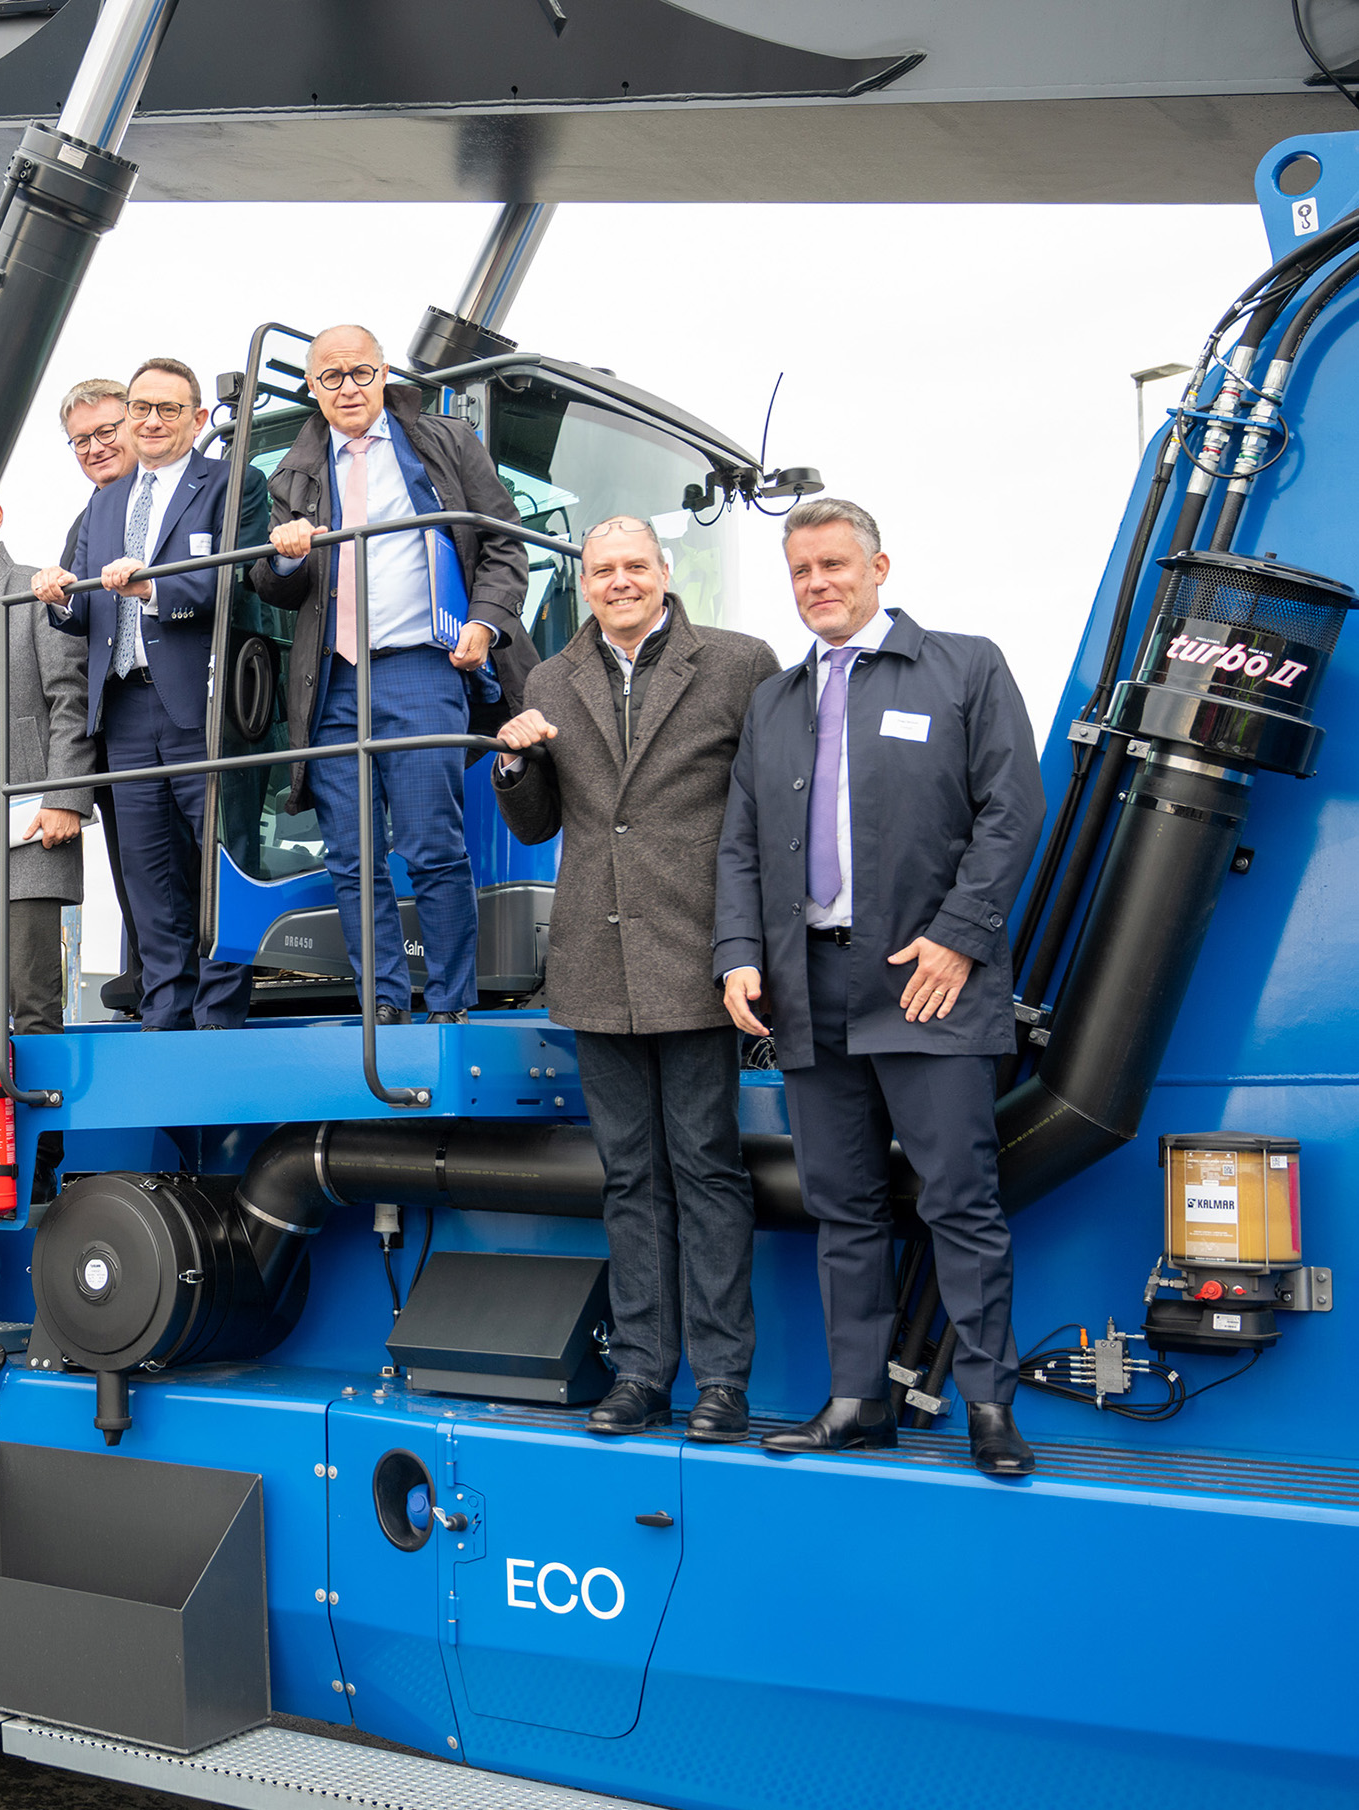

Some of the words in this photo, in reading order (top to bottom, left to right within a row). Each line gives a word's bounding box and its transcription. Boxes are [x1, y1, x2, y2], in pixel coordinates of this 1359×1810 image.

[1165, 634, 1279, 678] turbo
[1265, 659, 1309, 688] II
[1197, 1198, 1235, 1210] KALMAR
[506, 1557, 626, 1620] ECO
